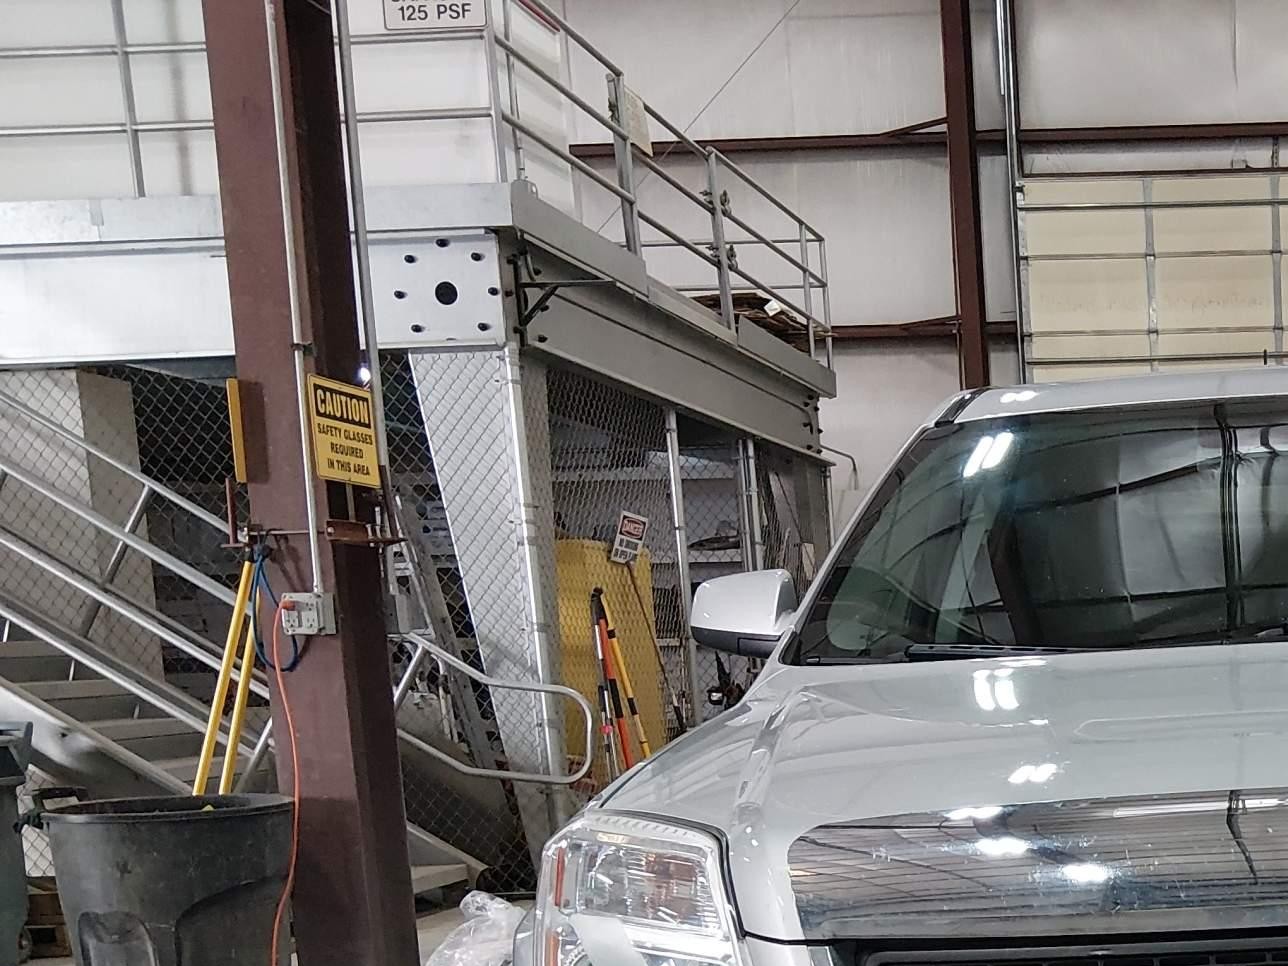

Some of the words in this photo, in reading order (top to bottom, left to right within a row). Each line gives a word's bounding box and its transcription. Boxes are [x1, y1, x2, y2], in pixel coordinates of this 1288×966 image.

[398, 5, 428, 21] 125
[437, 3, 472, 20] PSF
[316, 389, 369, 424] CAUTION
[317, 423, 342, 438] SAFETY
[343, 429, 373, 445] GLASSES
[330, 442, 364, 459] REQUIRED
[327, 458, 335, 469] IN
[336, 460, 352, 473] THIS
[353, 464, 371, 476] AREA
